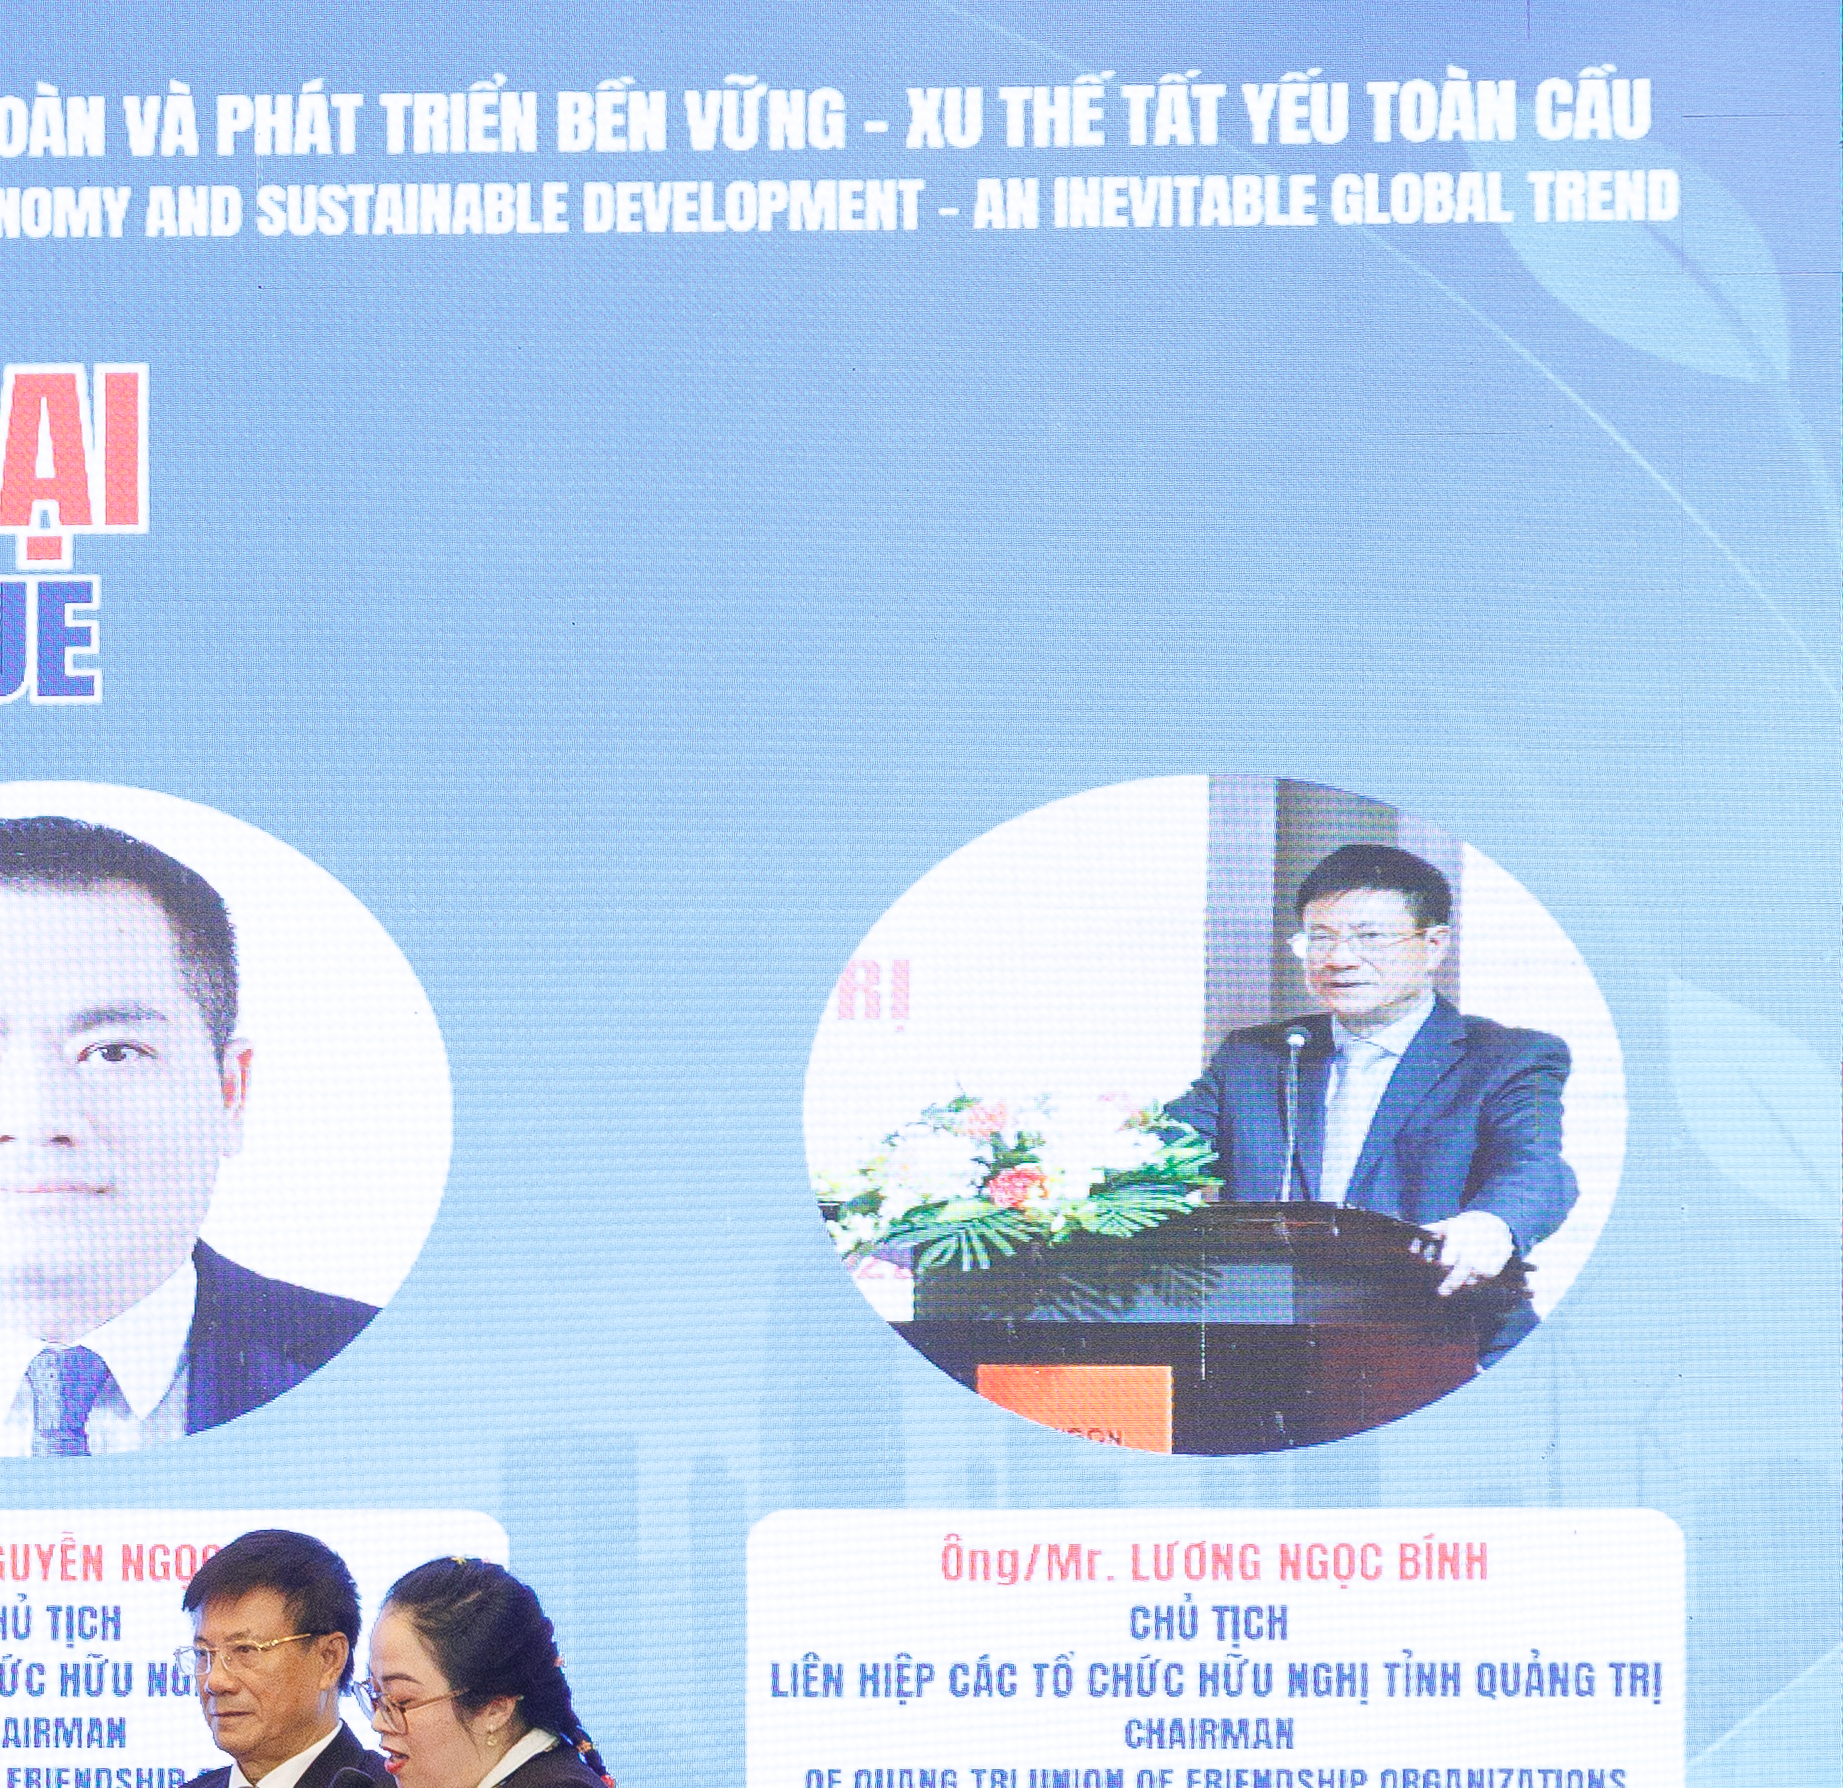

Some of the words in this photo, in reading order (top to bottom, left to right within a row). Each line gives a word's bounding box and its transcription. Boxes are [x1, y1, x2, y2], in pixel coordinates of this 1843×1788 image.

[122, 80, 199, 157] VÀ
[216, 78, 364, 156] PHÁT
[905, 86, 983, 150] XU
[998, 70, 1113, 148] THẾ
[1120, 69, 1227, 147] TẤT
[1241, 67, 1349, 145] YẾU
[1365, 65, 1517, 143] TOÀN
[145, 185, 243, 238] AND
[256, 181, 569, 237] SUSTAINABLE
[582, 178, 925, 234] DEVELOPMENT
[972, 177, 1039, 230] AN
[1053, 173, 1317, 229] INEVITABLE
[1330, 170, 1515, 226] GLOBAL
[1526, 168, 1680, 224] TREND
[940, 1532, 1115, 1587] Ông/Mr.
[1131, 1539, 1261, 1582] LƯƠNG
[1278, 1542, 1383, 1590] NGỌC
[44, 1603, 122, 1650] TỊCH
[1128, 1591, 1200, 1642] CHỦ
[1210, 1603, 1290, 1649] TỊCH
[58, 1651, 135, 1699] HỮU
[769, 1650, 845, 1699] LIÊN
[857, 1651, 937, 1707] HIỆP
[947, 1652, 1019, 1699] CÁC
[1031, 1650, 1076, 1699] TỔ
[1086, 1652, 1186, 1699] CHỨC
[1197, 1651, 1274, 1699] HỮU
[1286, 1661, 1370, 1707] NGHỊ
[1382, 1647, 1462, 1699] TỈNH
[1474, 1647, 1597, 1701] QUẢNG
[1606, 1660, 1663, 1706] TRỊ
[1123, 1716, 1296, 1751] CHAIRMAN
